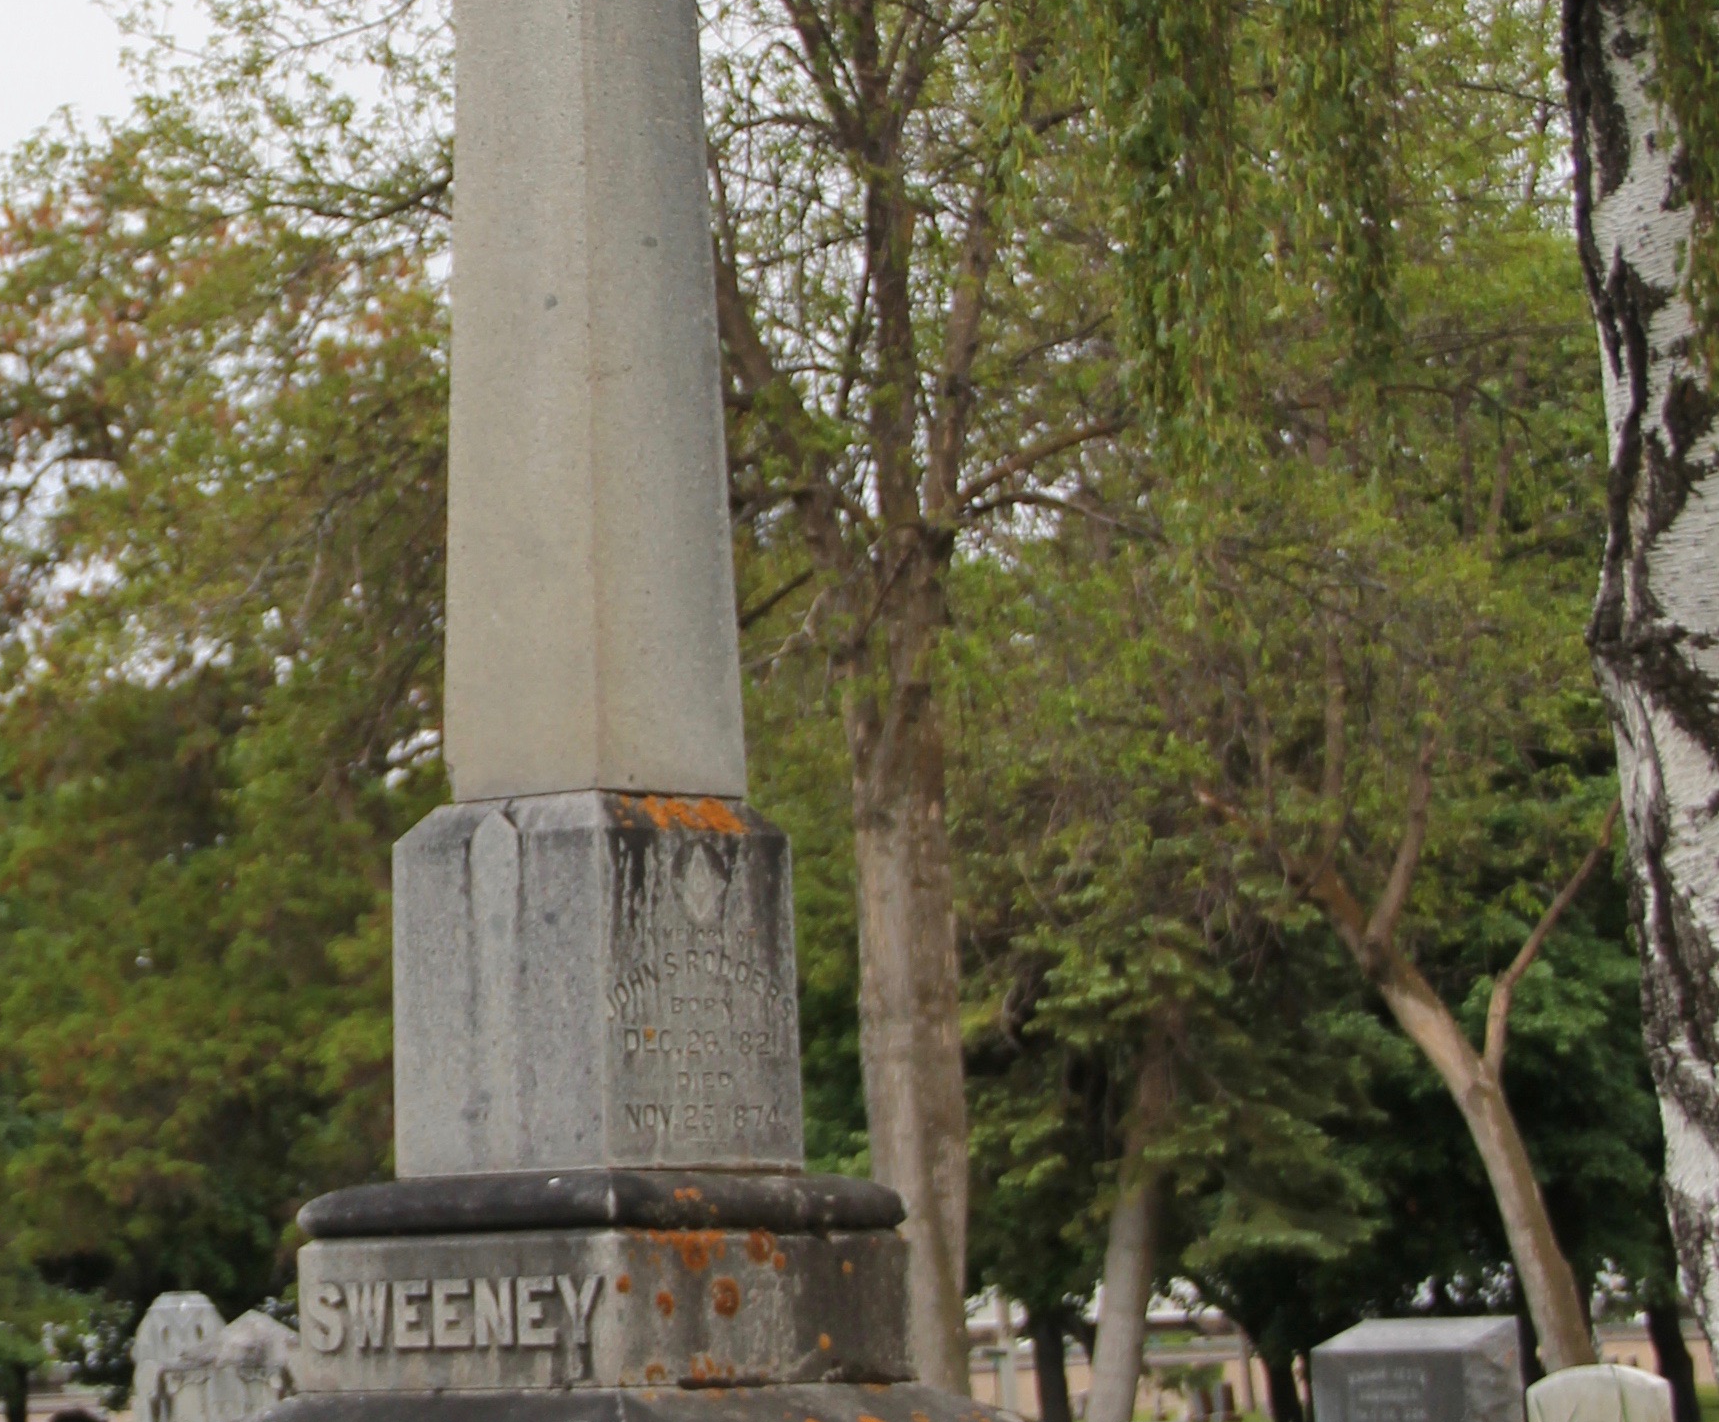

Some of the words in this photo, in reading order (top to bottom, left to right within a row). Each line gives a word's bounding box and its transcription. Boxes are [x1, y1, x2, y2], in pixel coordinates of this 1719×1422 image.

[606, 962, 661, 1021] JOHN
[678, 1071, 732, 1088] DIED
[307, 1274, 606, 1354] SWEENEY
